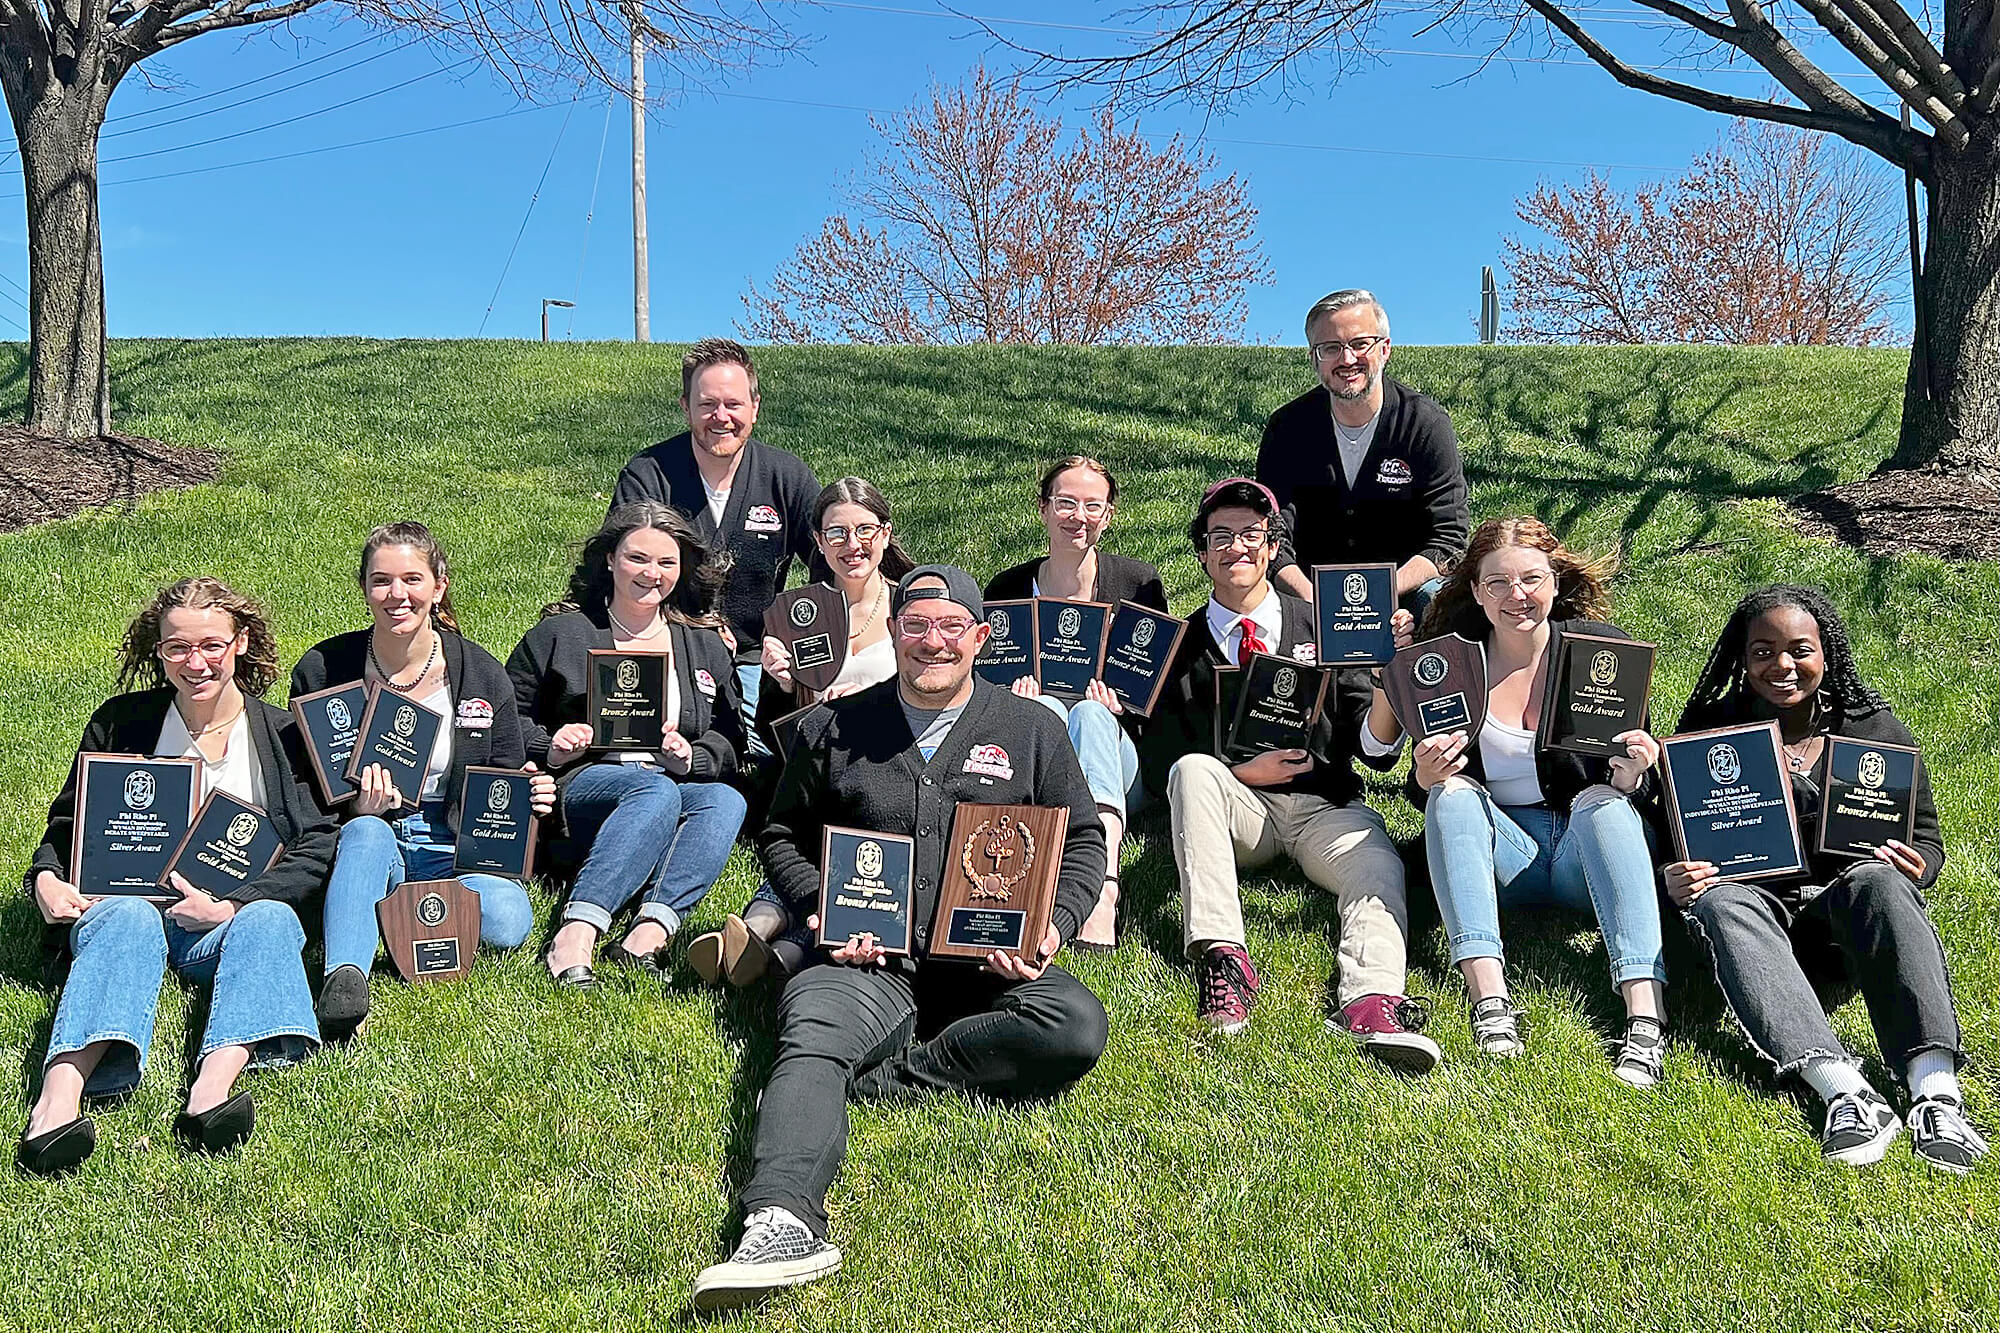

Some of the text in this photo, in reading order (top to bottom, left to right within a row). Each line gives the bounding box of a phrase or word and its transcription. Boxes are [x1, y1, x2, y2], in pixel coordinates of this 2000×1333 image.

[1333, 621, 1381, 631] Gold Award
[1001, 654, 1027, 664] Award
[1039, 652, 1091, 665] Bronze Award
[1106, 655, 1154, 678] Bronze Award
[1583, 685, 1617, 696] Phi Rho Pi
[600, 708, 629, 716] Bronze
[1570, 703, 1625, 718] Gold Award
[1249, 709, 1304, 728] Bronze Award
[330, 751, 351, 763] Silver
[375, 743, 417, 768] Gold Award
[1710, 785, 1750, 797] Phi Rho Pi
[1853, 787, 1865, 795] Phi
[1865, 789, 1878, 797] Rho
[1702, 792, 1761, 805] National Championships
[1708, 797, 1758, 809] WYMAN DIVISION
[1684, 798, 1784, 819] INDIVIDUAL EVENTS SWEEPSTAKES
[1836, 804, 1901, 823] Bronze Award
[119, 812, 132, 820] Phi
[1711, 815, 1763, 831] Silver Award
[472, 828, 517, 840] Gold Award
[109, 843, 162, 852] Silver Award
[215, 839, 247, 858] Phi Rho Pi
[196, 852, 248, 880] Gold Award
[835, 894, 899, 912] Bronze Award
